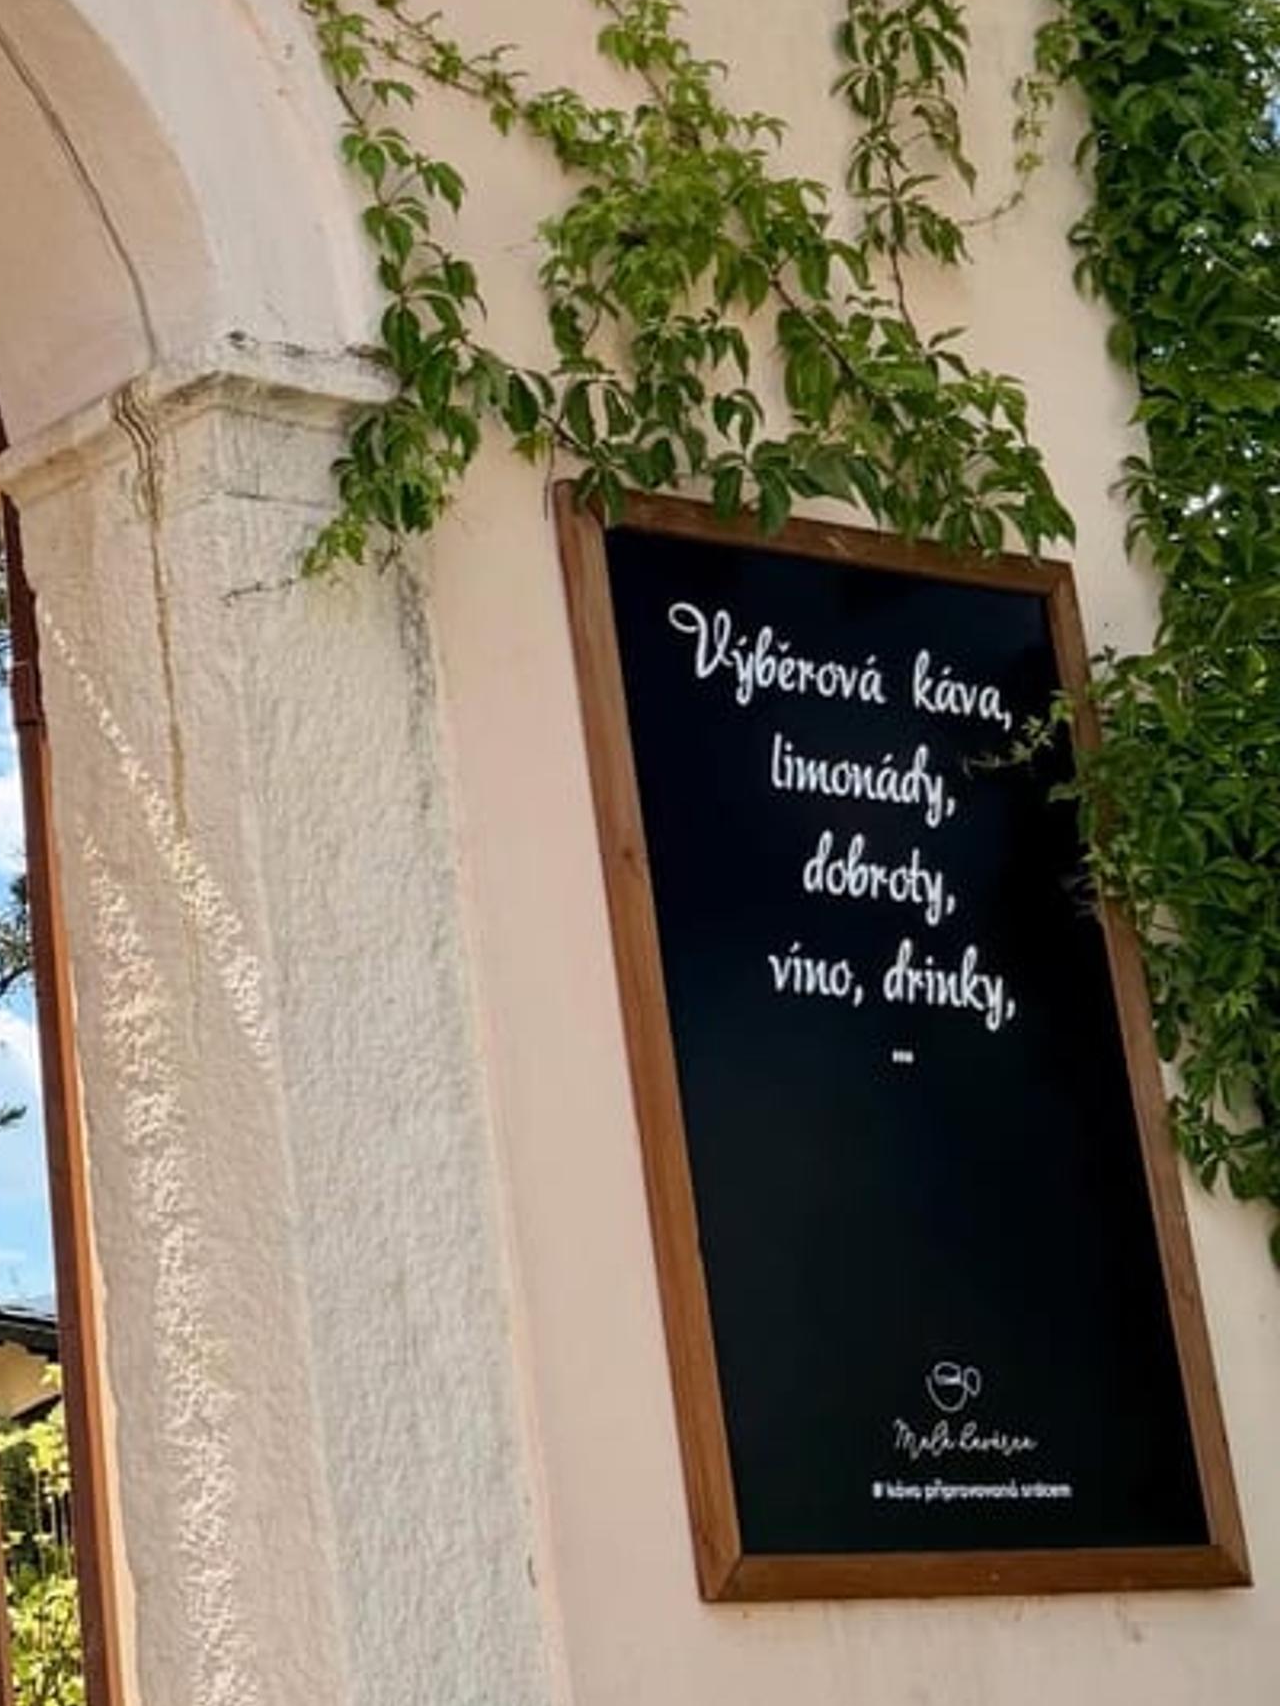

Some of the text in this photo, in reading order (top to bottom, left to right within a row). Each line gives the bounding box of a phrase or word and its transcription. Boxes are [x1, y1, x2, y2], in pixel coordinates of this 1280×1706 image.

[668, 602, 1013, 731] Výběrová káva,
[771, 733, 957, 828] limonády,
[803, 830, 957, 926] dobroty,
[767, 938, 1017, 1032] víno, drinky,
